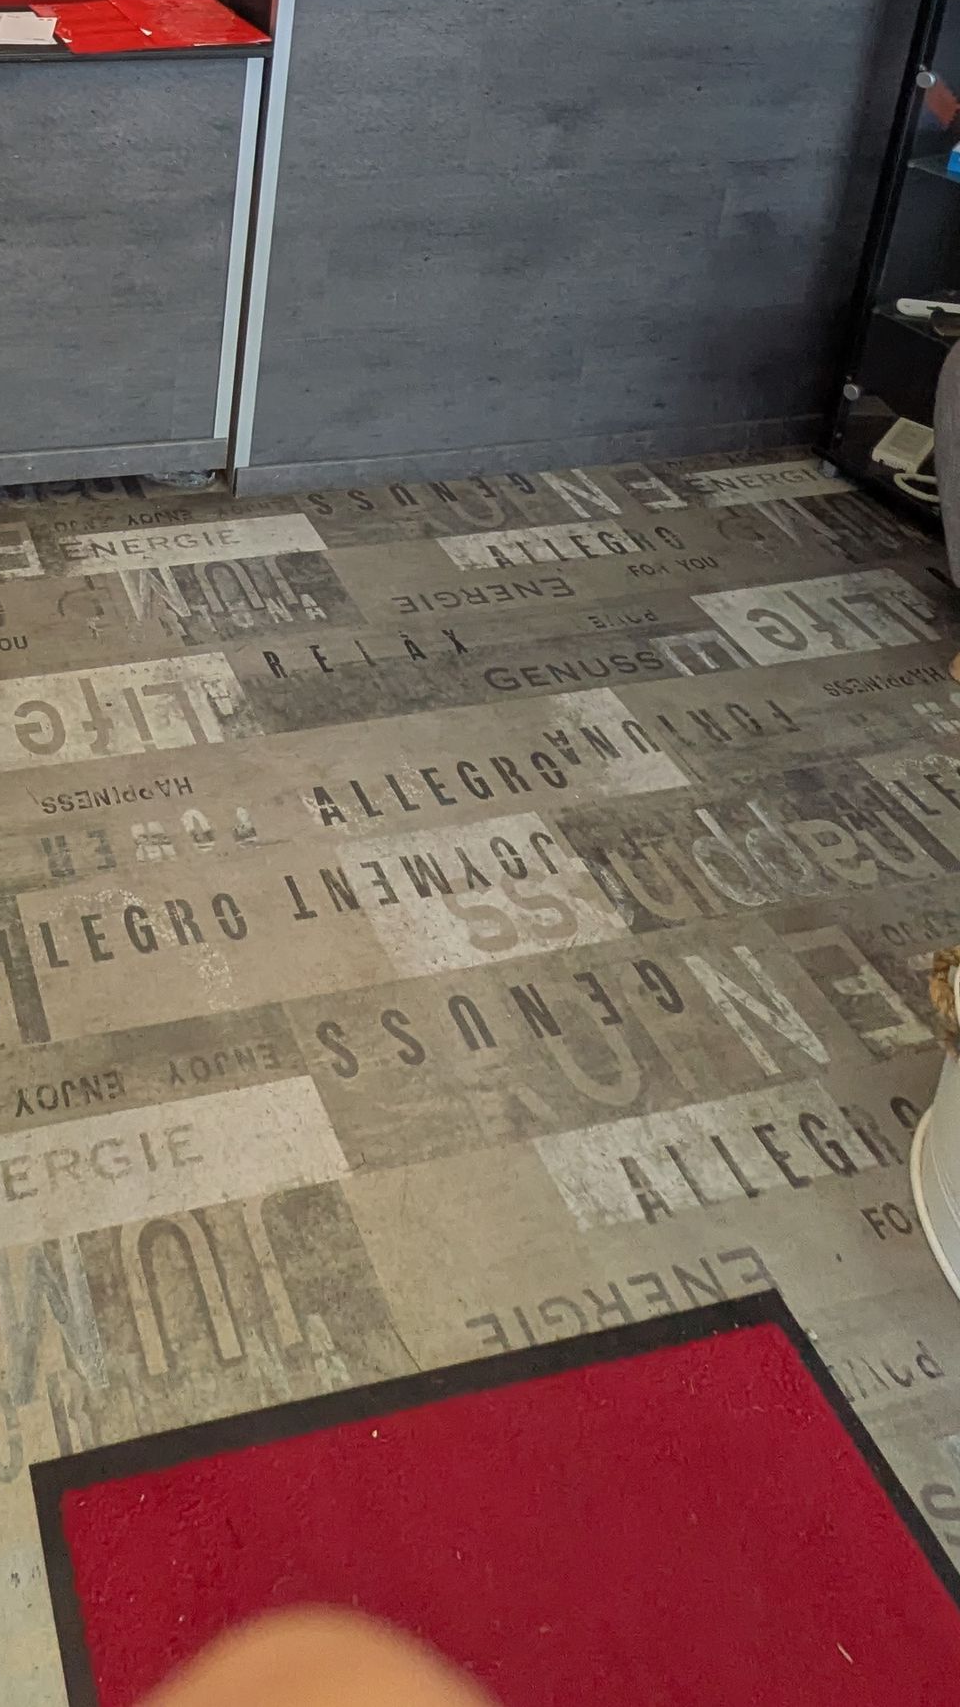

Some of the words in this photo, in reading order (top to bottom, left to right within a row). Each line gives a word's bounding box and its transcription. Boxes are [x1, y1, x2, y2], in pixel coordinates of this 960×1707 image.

[62, 528, 243, 562] ENERGIE
[484, 650, 666, 693] GENUSS
[313, 750, 569, 828] ALLEGRO
[315, 959, 684, 1079] GENUSS
[15, 1069, 127, 1120] ENJOY
[861, 1200, 917, 1241] FO
